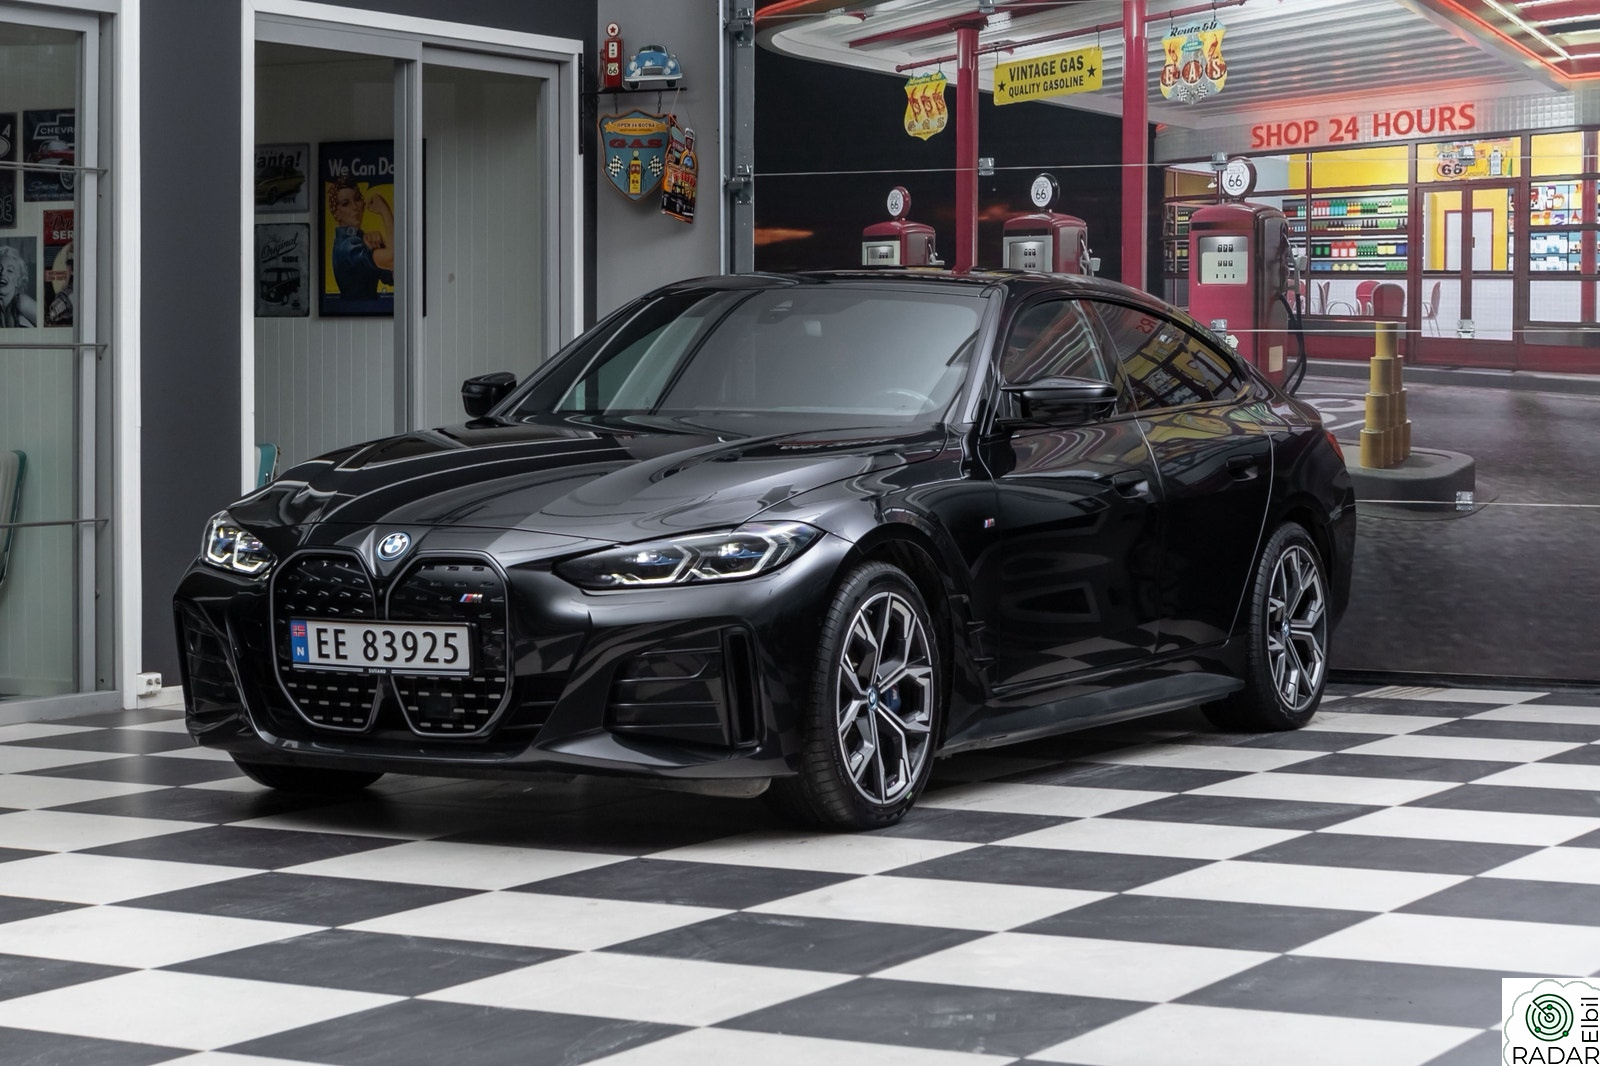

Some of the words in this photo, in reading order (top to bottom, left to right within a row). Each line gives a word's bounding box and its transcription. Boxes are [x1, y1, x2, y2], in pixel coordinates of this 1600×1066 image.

[1170, 26, 1200, 37] Route
[608, 66, 618, 75] 66
[1009, 60, 1056, 82] VINTAGE
[1060, 55, 1084, 73] GAS
[1008, 82, 1041, 98] QUALITY
[1043, 75, 1084, 92] GASOLINE
[40, 126, 75, 135] CHEVR
[1251, 119, 1319, 149] SHOP
[1328, 116, 1359, 142] 24
[1373, 103, 1475, 138] HOURS
[608, 138, 663, 149] GAS
[255, 151, 302, 168] anta!
[327, 158, 349, 177] We
[350, 157, 376, 177] Can
[1441, 163, 1463, 175] 66
[1228, 174, 1243, 188] 66
[1035, 188, 1046, 199] 66
[890, 199, 899, 210] 66
[261, 232, 298, 260] Original
[296, 646, 305, 656] N
[316, 627, 348, 660] EE
[362, 629, 460, 664] 83925
